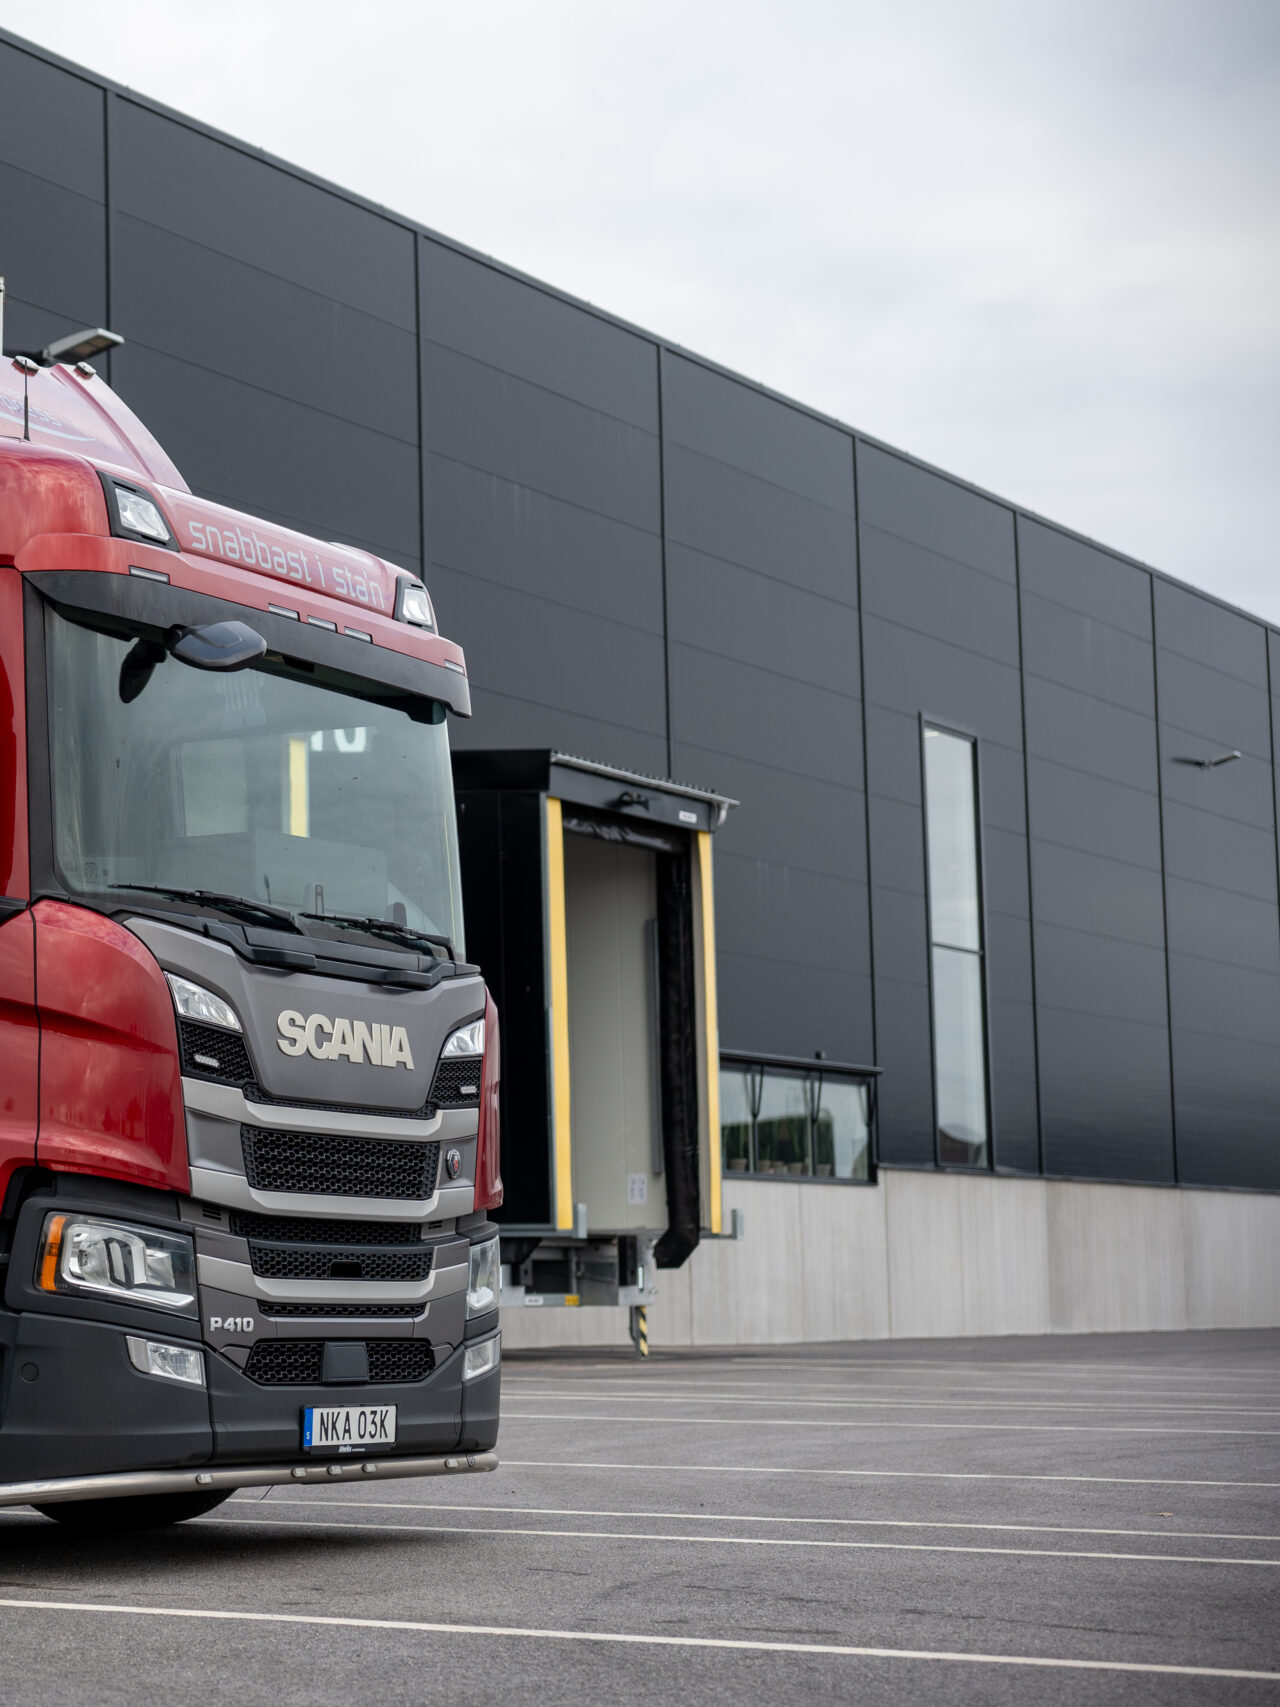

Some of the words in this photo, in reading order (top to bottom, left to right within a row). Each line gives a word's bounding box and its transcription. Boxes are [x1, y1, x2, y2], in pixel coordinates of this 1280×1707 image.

[188, 520, 312, 583] snabbast
[315, 554, 326, 587] i
[276, 1009, 415, 1070] SCANIA
[319, 1411, 352, 1442] NKA
